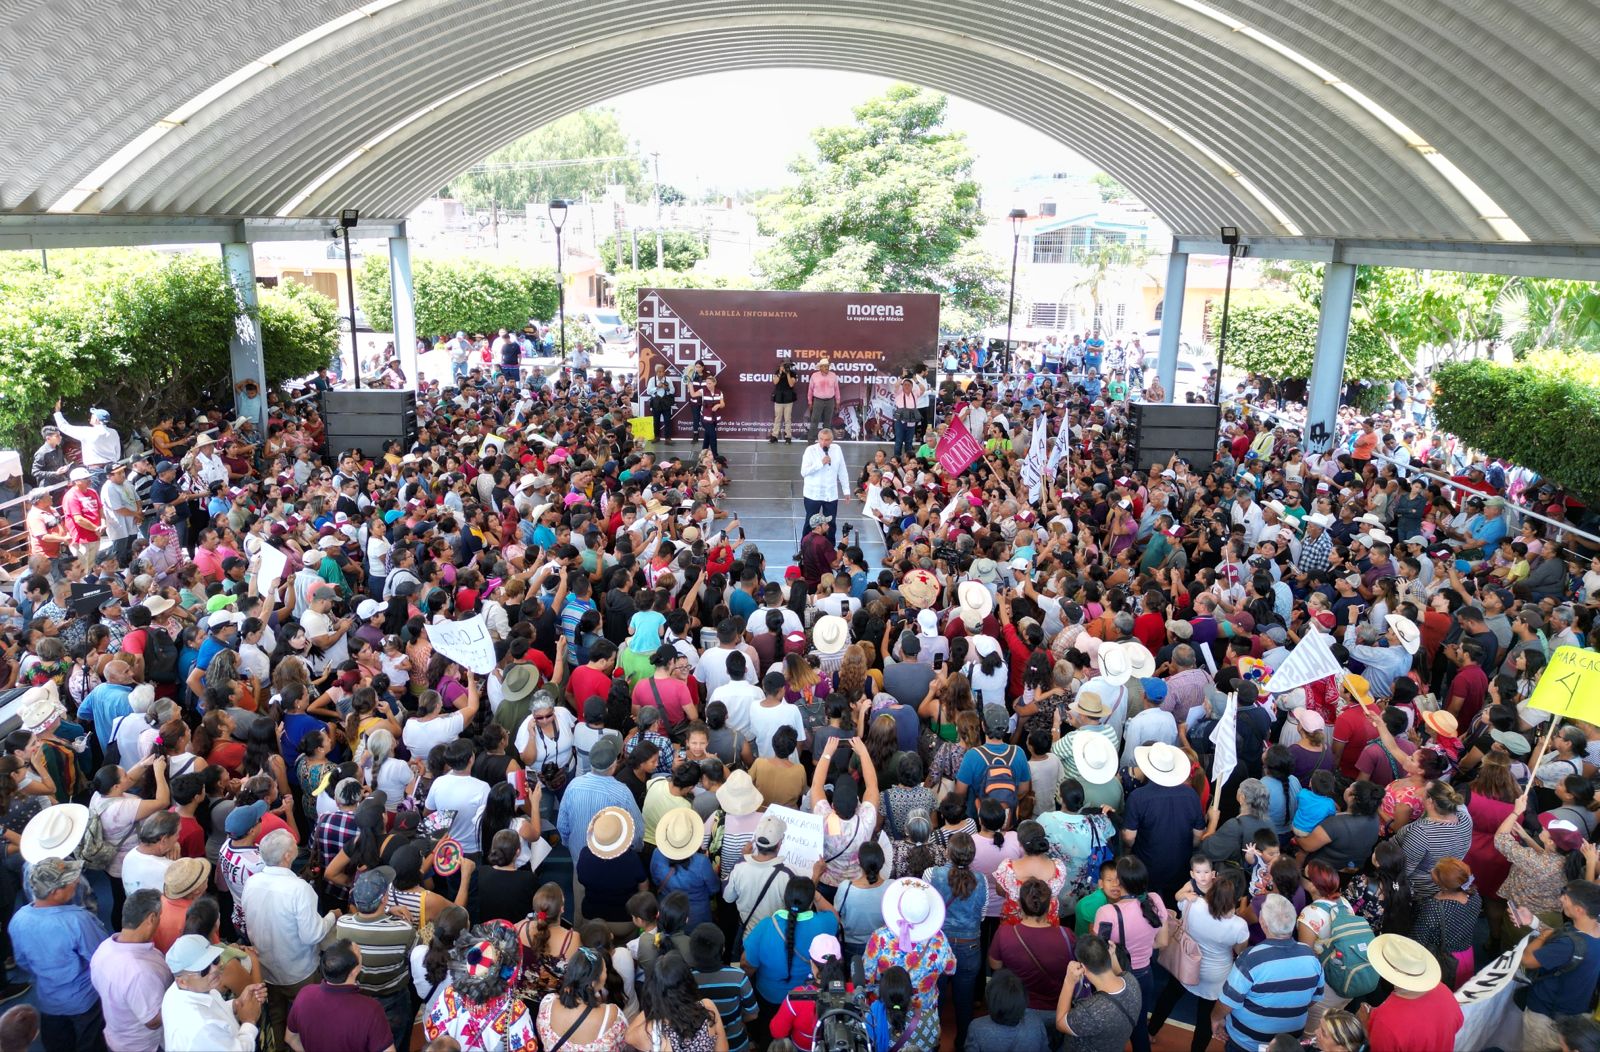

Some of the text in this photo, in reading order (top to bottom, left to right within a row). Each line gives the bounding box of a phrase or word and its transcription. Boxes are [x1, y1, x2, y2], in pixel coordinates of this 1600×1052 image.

[699, 310, 741, 318] ASAMBLEA
[847, 304, 904, 316] morena
[776, 350, 886, 361] EN TEPIC, NAYARIT,
[829, 363, 877, 372] AGUSTO.
